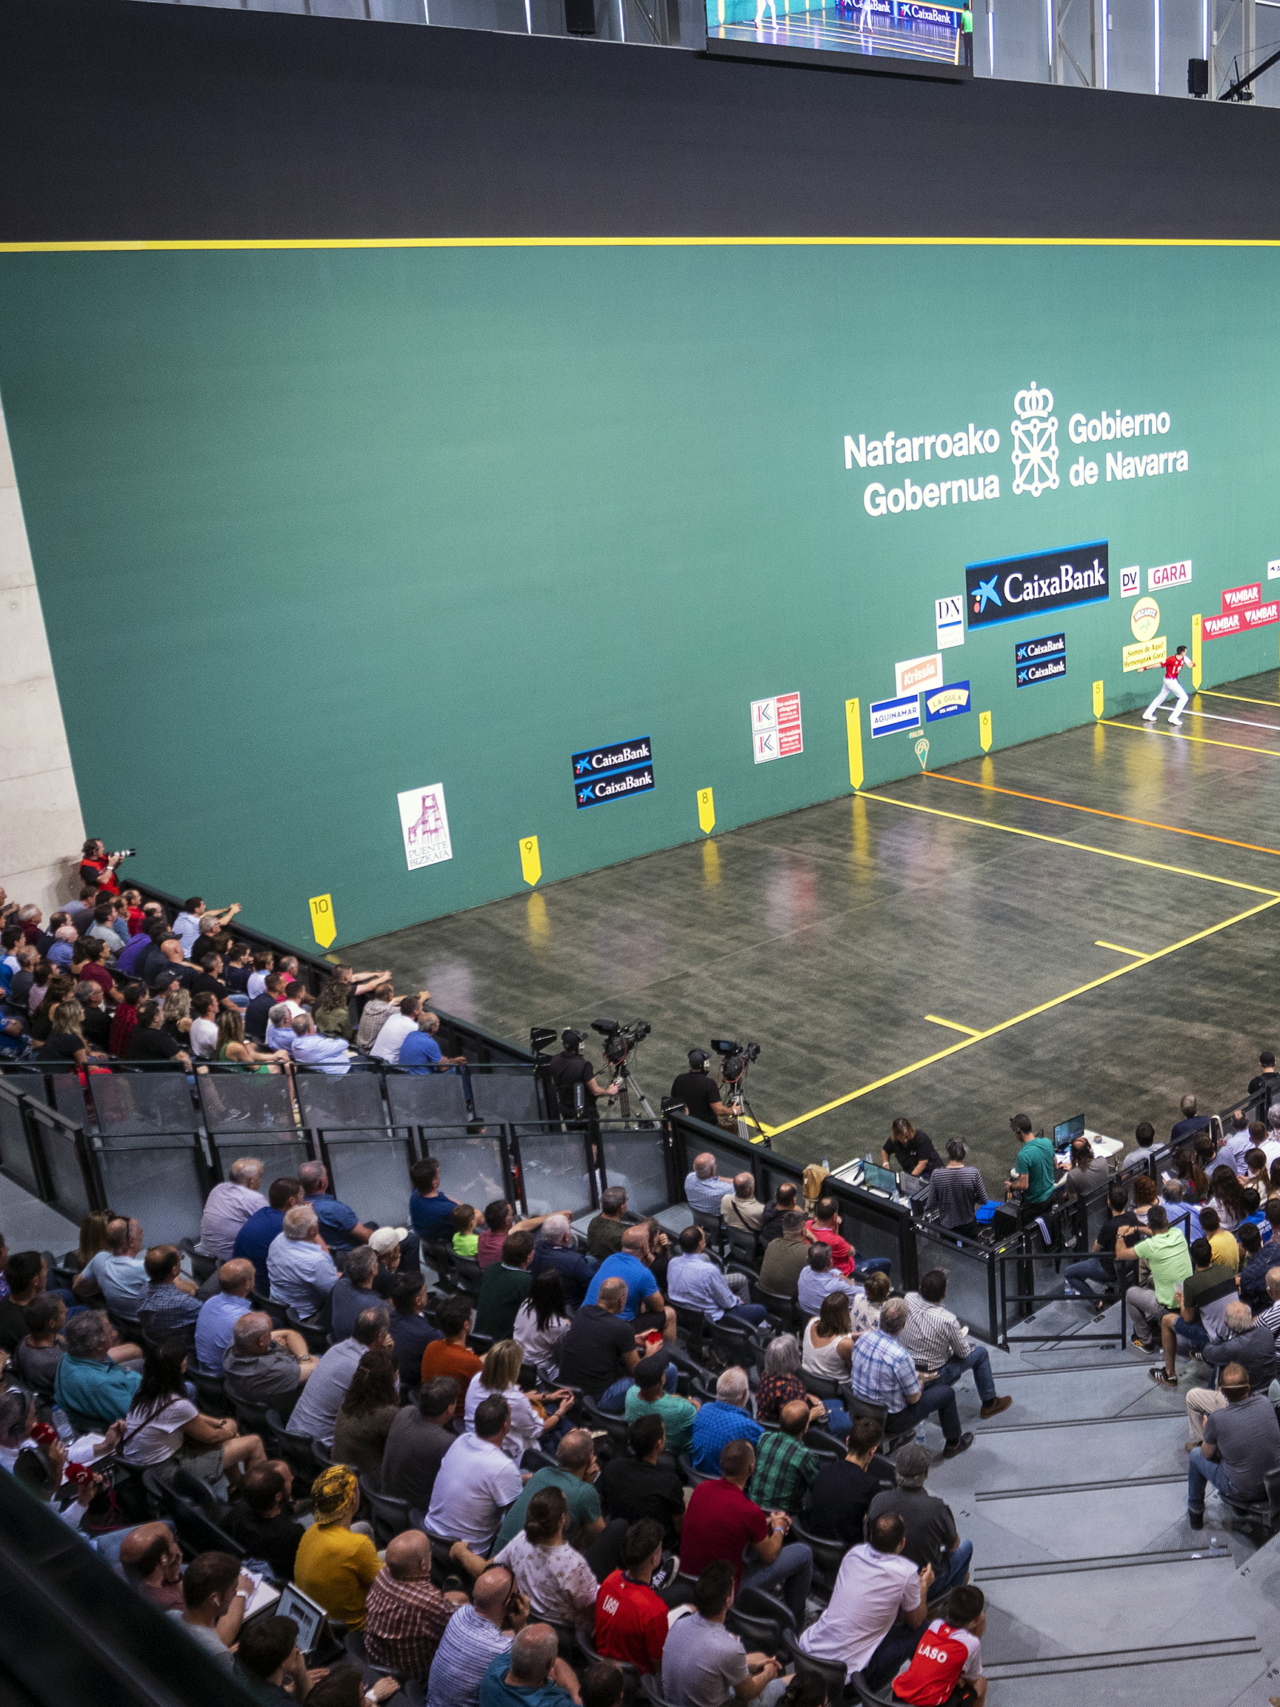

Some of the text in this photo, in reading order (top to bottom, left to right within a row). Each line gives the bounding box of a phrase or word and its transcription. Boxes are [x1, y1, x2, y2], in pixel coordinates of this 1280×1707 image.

[911, 5, 951, 24] CaixaBank
[1068, 409, 1170, 444] Gobierno
[844, 423, 1000, 469] Nafarroako
[1069, 449, 1189, 487] de Navarra
[863, 474, 1000, 517] Gobernua
[1003, 558, 1106, 603] CaixaBank
[1122, 571, 1137, 587] DV
[1153, 564, 1187, 585] GARA
[1230, 587, 1259, 605] AMBAR
[938, 597, 960, 620] DN
[1250, 604, 1278, 622] AMBAR
[1194, 617, 1199, 626] 4
[1211, 614, 1240, 633] AMBAR
[1027, 638, 1065, 657] CaixaBank
[904, 662, 936, 687] Krissia
[1028, 661, 1066, 680] CaixaBank
[1095, 683, 1101, 694] 5
[849, 702, 855, 714] 7
[943, 694, 962, 703] GULA
[874, 706, 917, 724] AGUINAMAR
[982, 714, 988, 726] 6
[591, 743, 650, 769] CaixaBank
[594, 771, 653, 797] CaixaBank
[702, 791, 709, 804] 8
[408, 840, 449, 859] PUENTE
[524, 840, 533, 854] 9
[409, 850, 450, 868] BIZKAIA
[312, 899, 329, 915] 10
[917, 1644, 948, 1664] LASO
